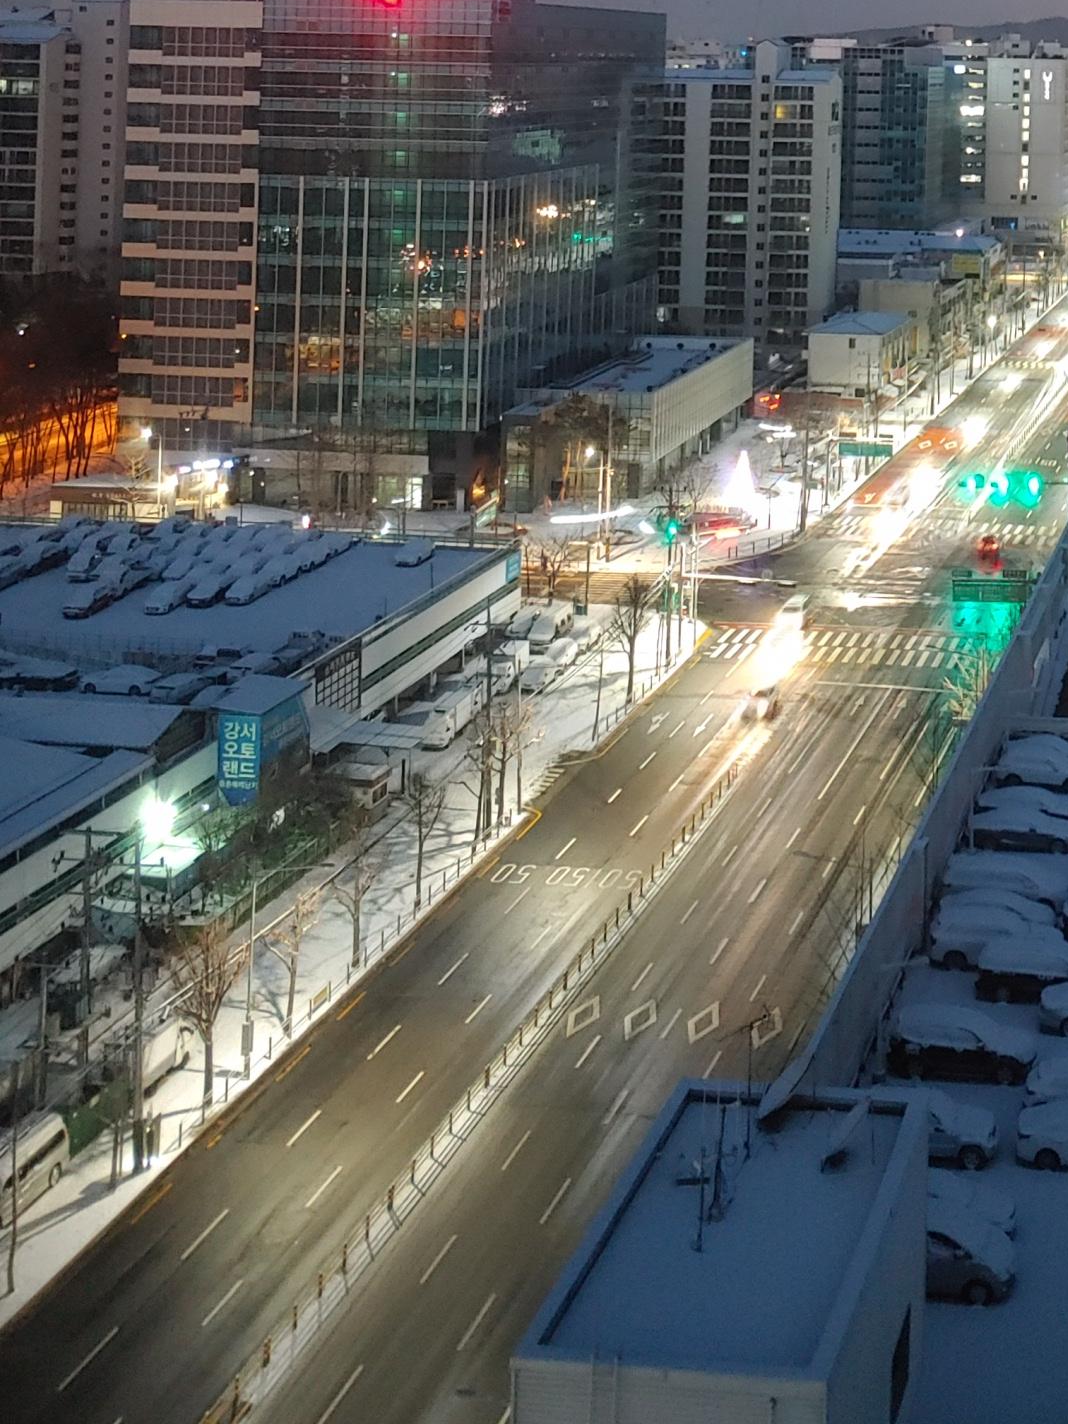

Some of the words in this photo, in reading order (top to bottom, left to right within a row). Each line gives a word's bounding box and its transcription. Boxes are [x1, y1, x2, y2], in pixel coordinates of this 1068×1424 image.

[223, 722, 257, 742] 강서
[222, 741, 257, 759] 오토
[222, 760, 257, 779] 랜드
